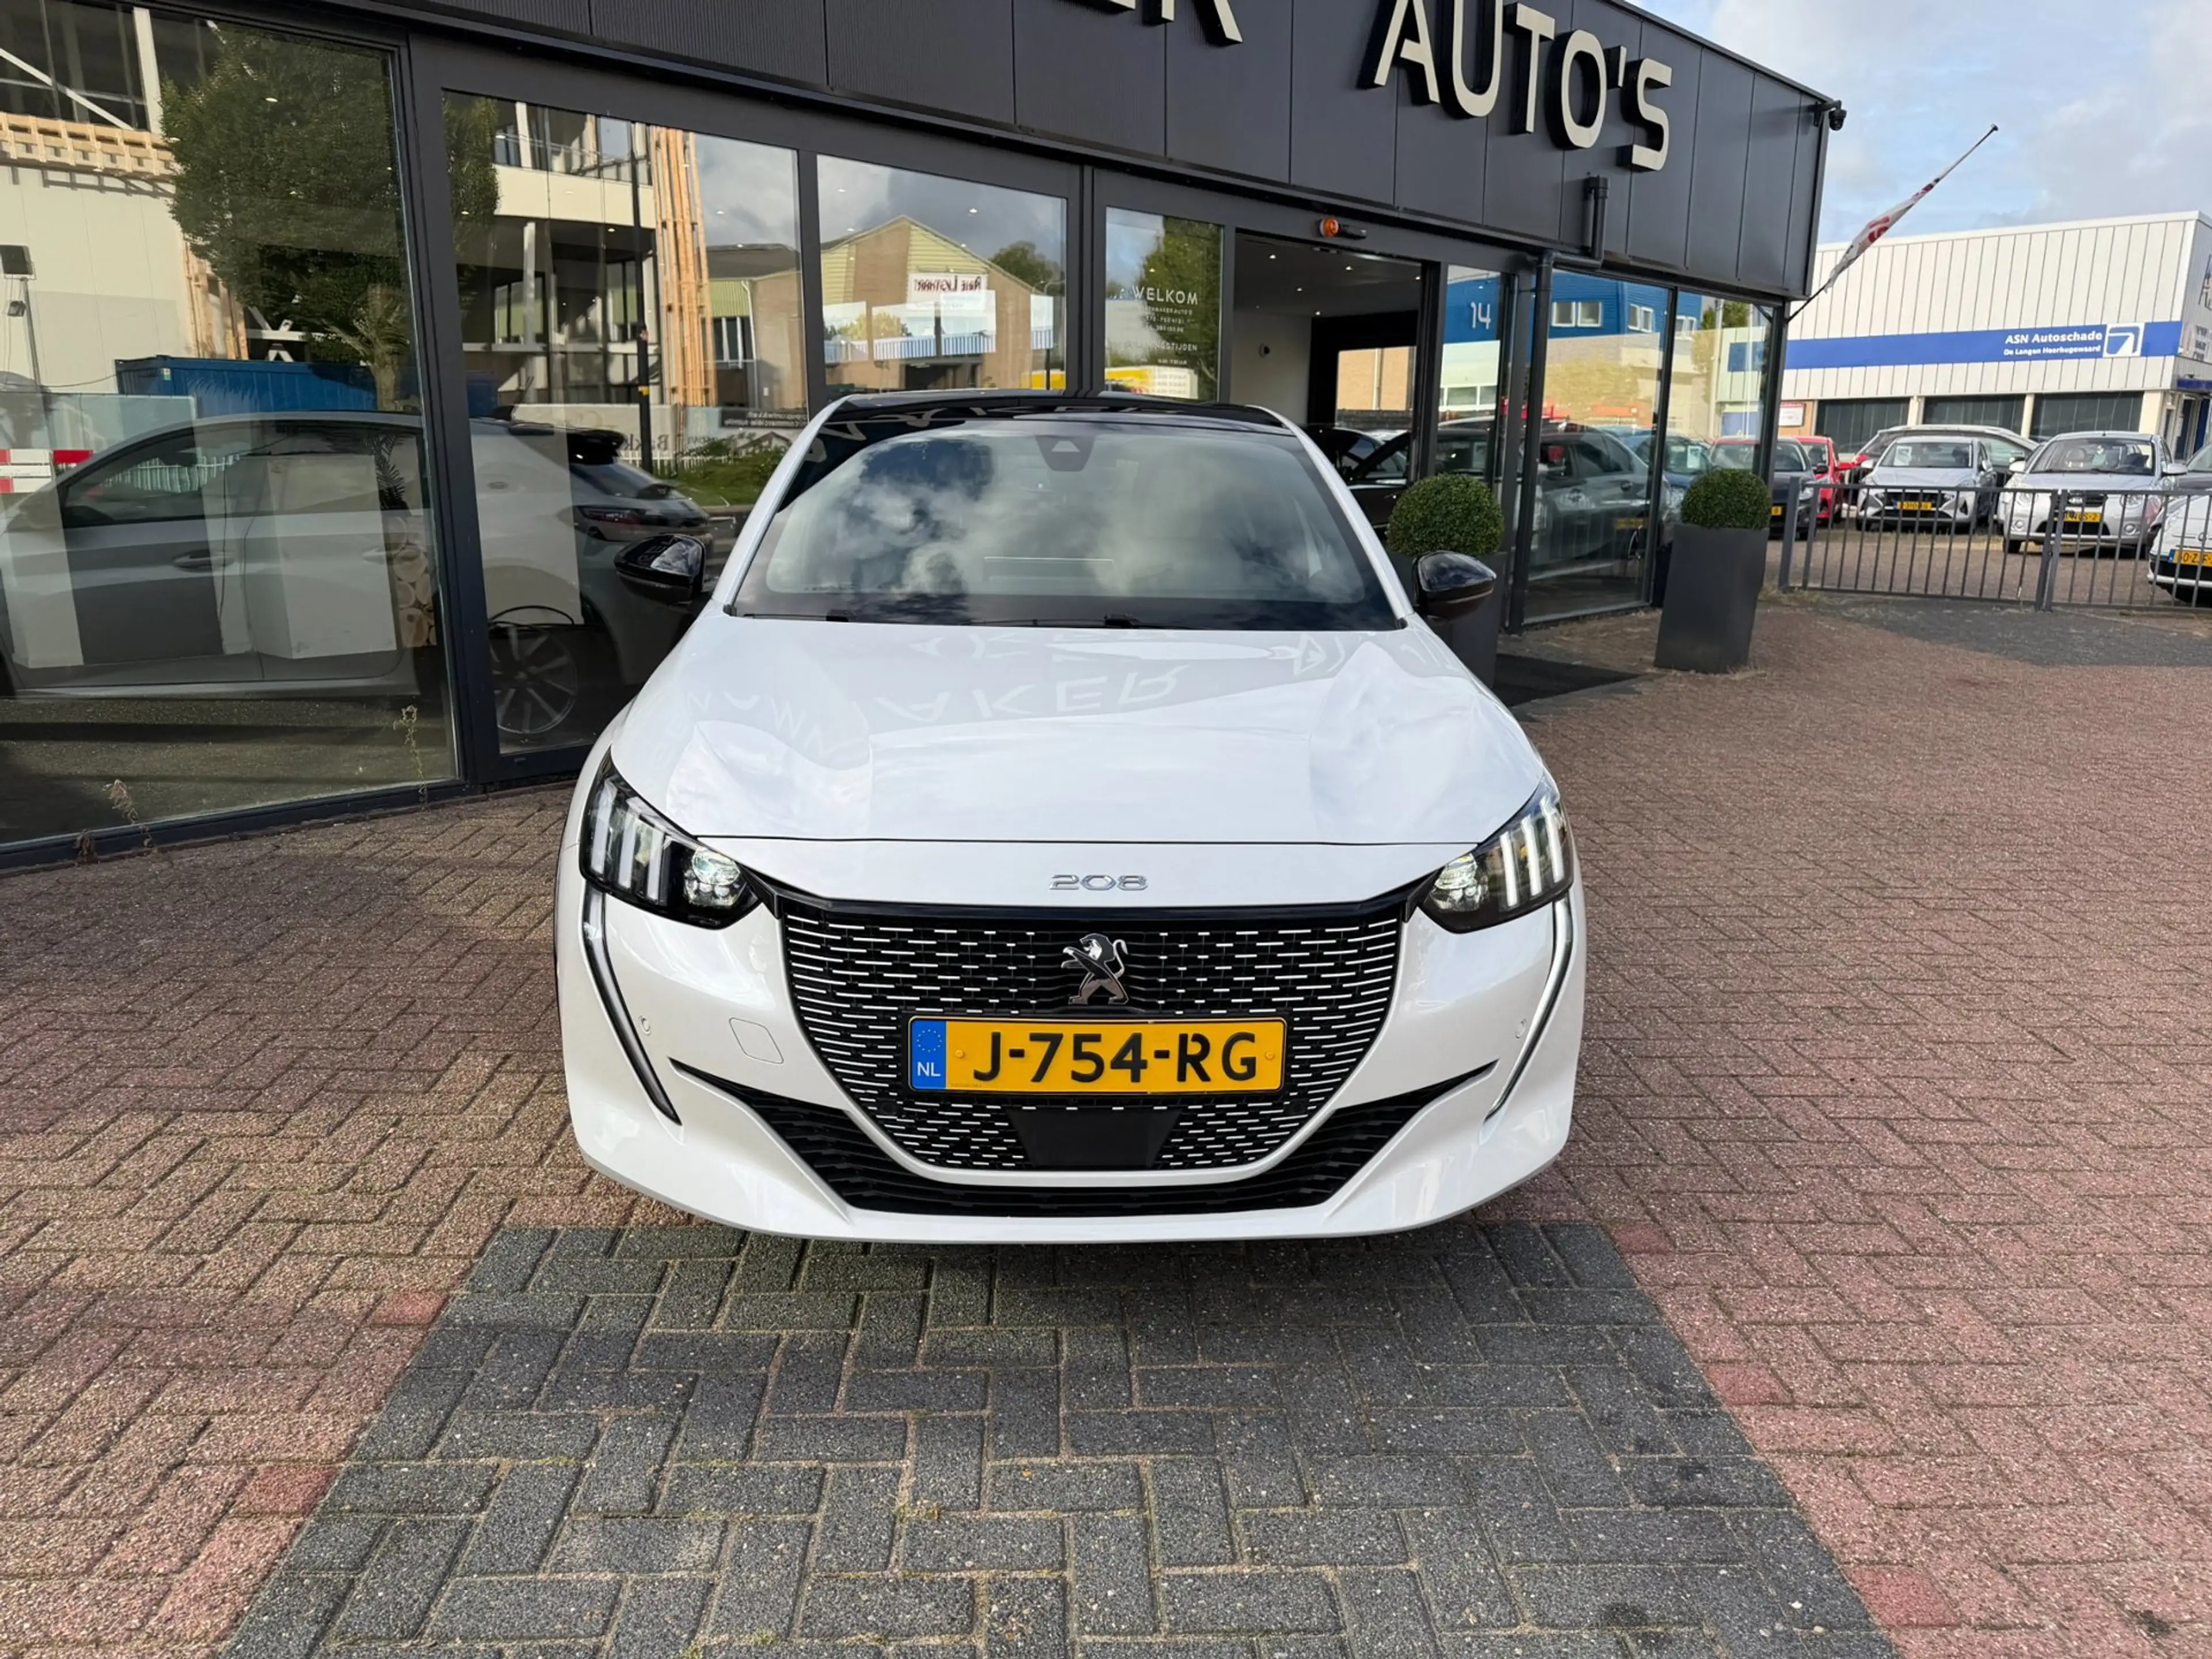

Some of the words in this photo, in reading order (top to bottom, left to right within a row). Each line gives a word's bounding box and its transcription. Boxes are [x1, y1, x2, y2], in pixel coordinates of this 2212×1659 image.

[1373, 0, 1673, 171] AUTO'S
[1132, 286, 1198, 305] WELKOM
[1470, 301, 1492, 329] 14
[2005, 334, 2029, 344] ASN
[2031, 331, 2103, 344] Autoschade
[2015, 347, 2041, 356] Langen
[2043, 345, 2101, 354] Heerhugowaard
[1048, 874, 1149, 891] 208
[973, 1032, 1256, 1084] J-754-RG
[917, 1062, 941, 1077] NL
